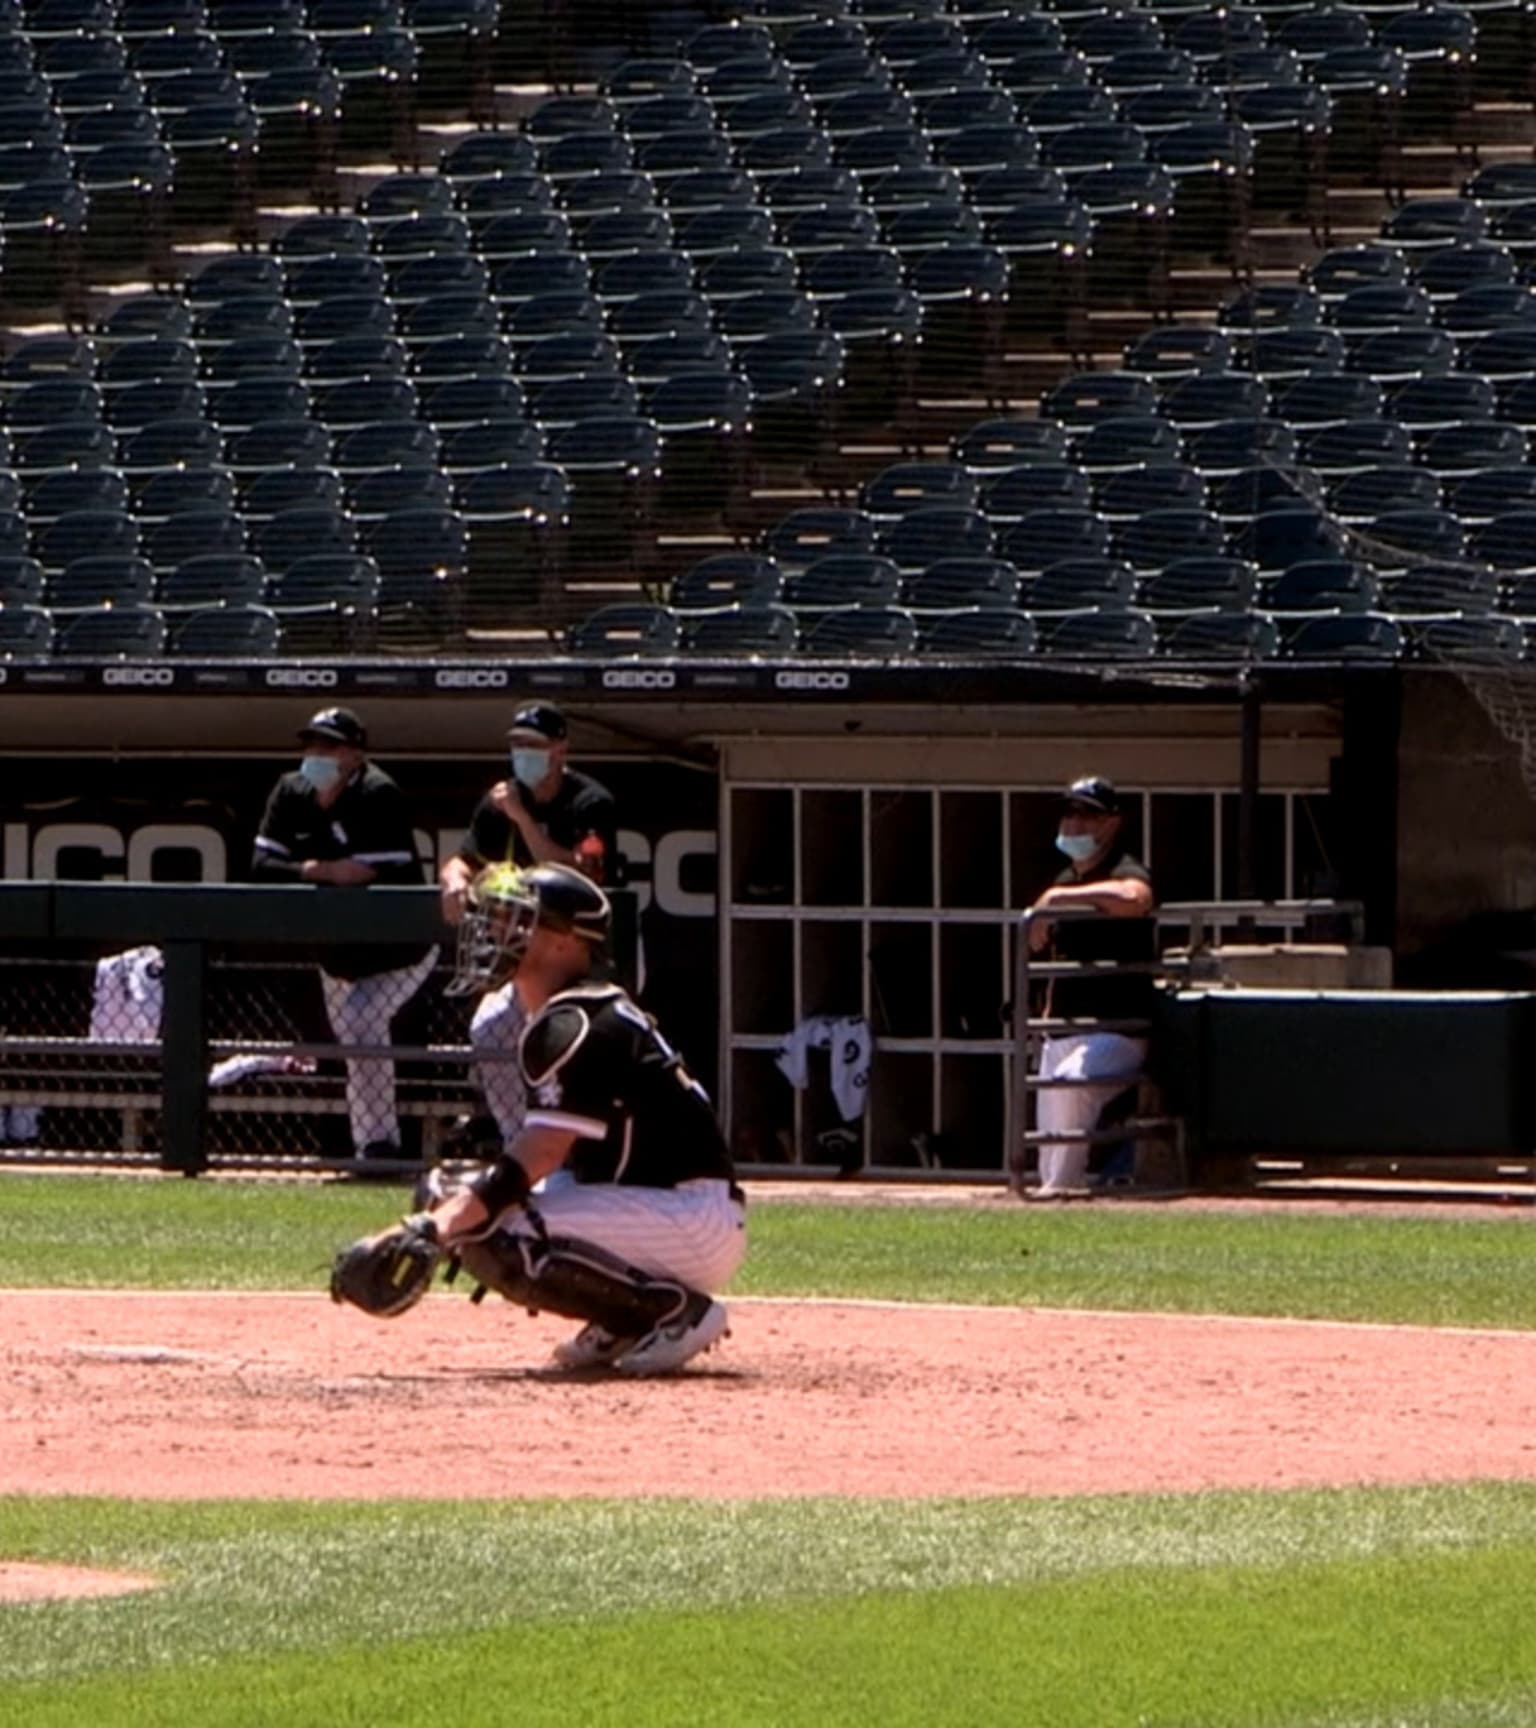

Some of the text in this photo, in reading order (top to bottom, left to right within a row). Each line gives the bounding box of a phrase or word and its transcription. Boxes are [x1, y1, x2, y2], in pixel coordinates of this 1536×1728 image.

[103, 668, 173, 684] GEICO
[266, 669, 337, 685] GEICO
[436, 670, 507, 686] GEICO
[603, 671, 675, 687] GEICO
[776, 672, 849, 688] GEICO
